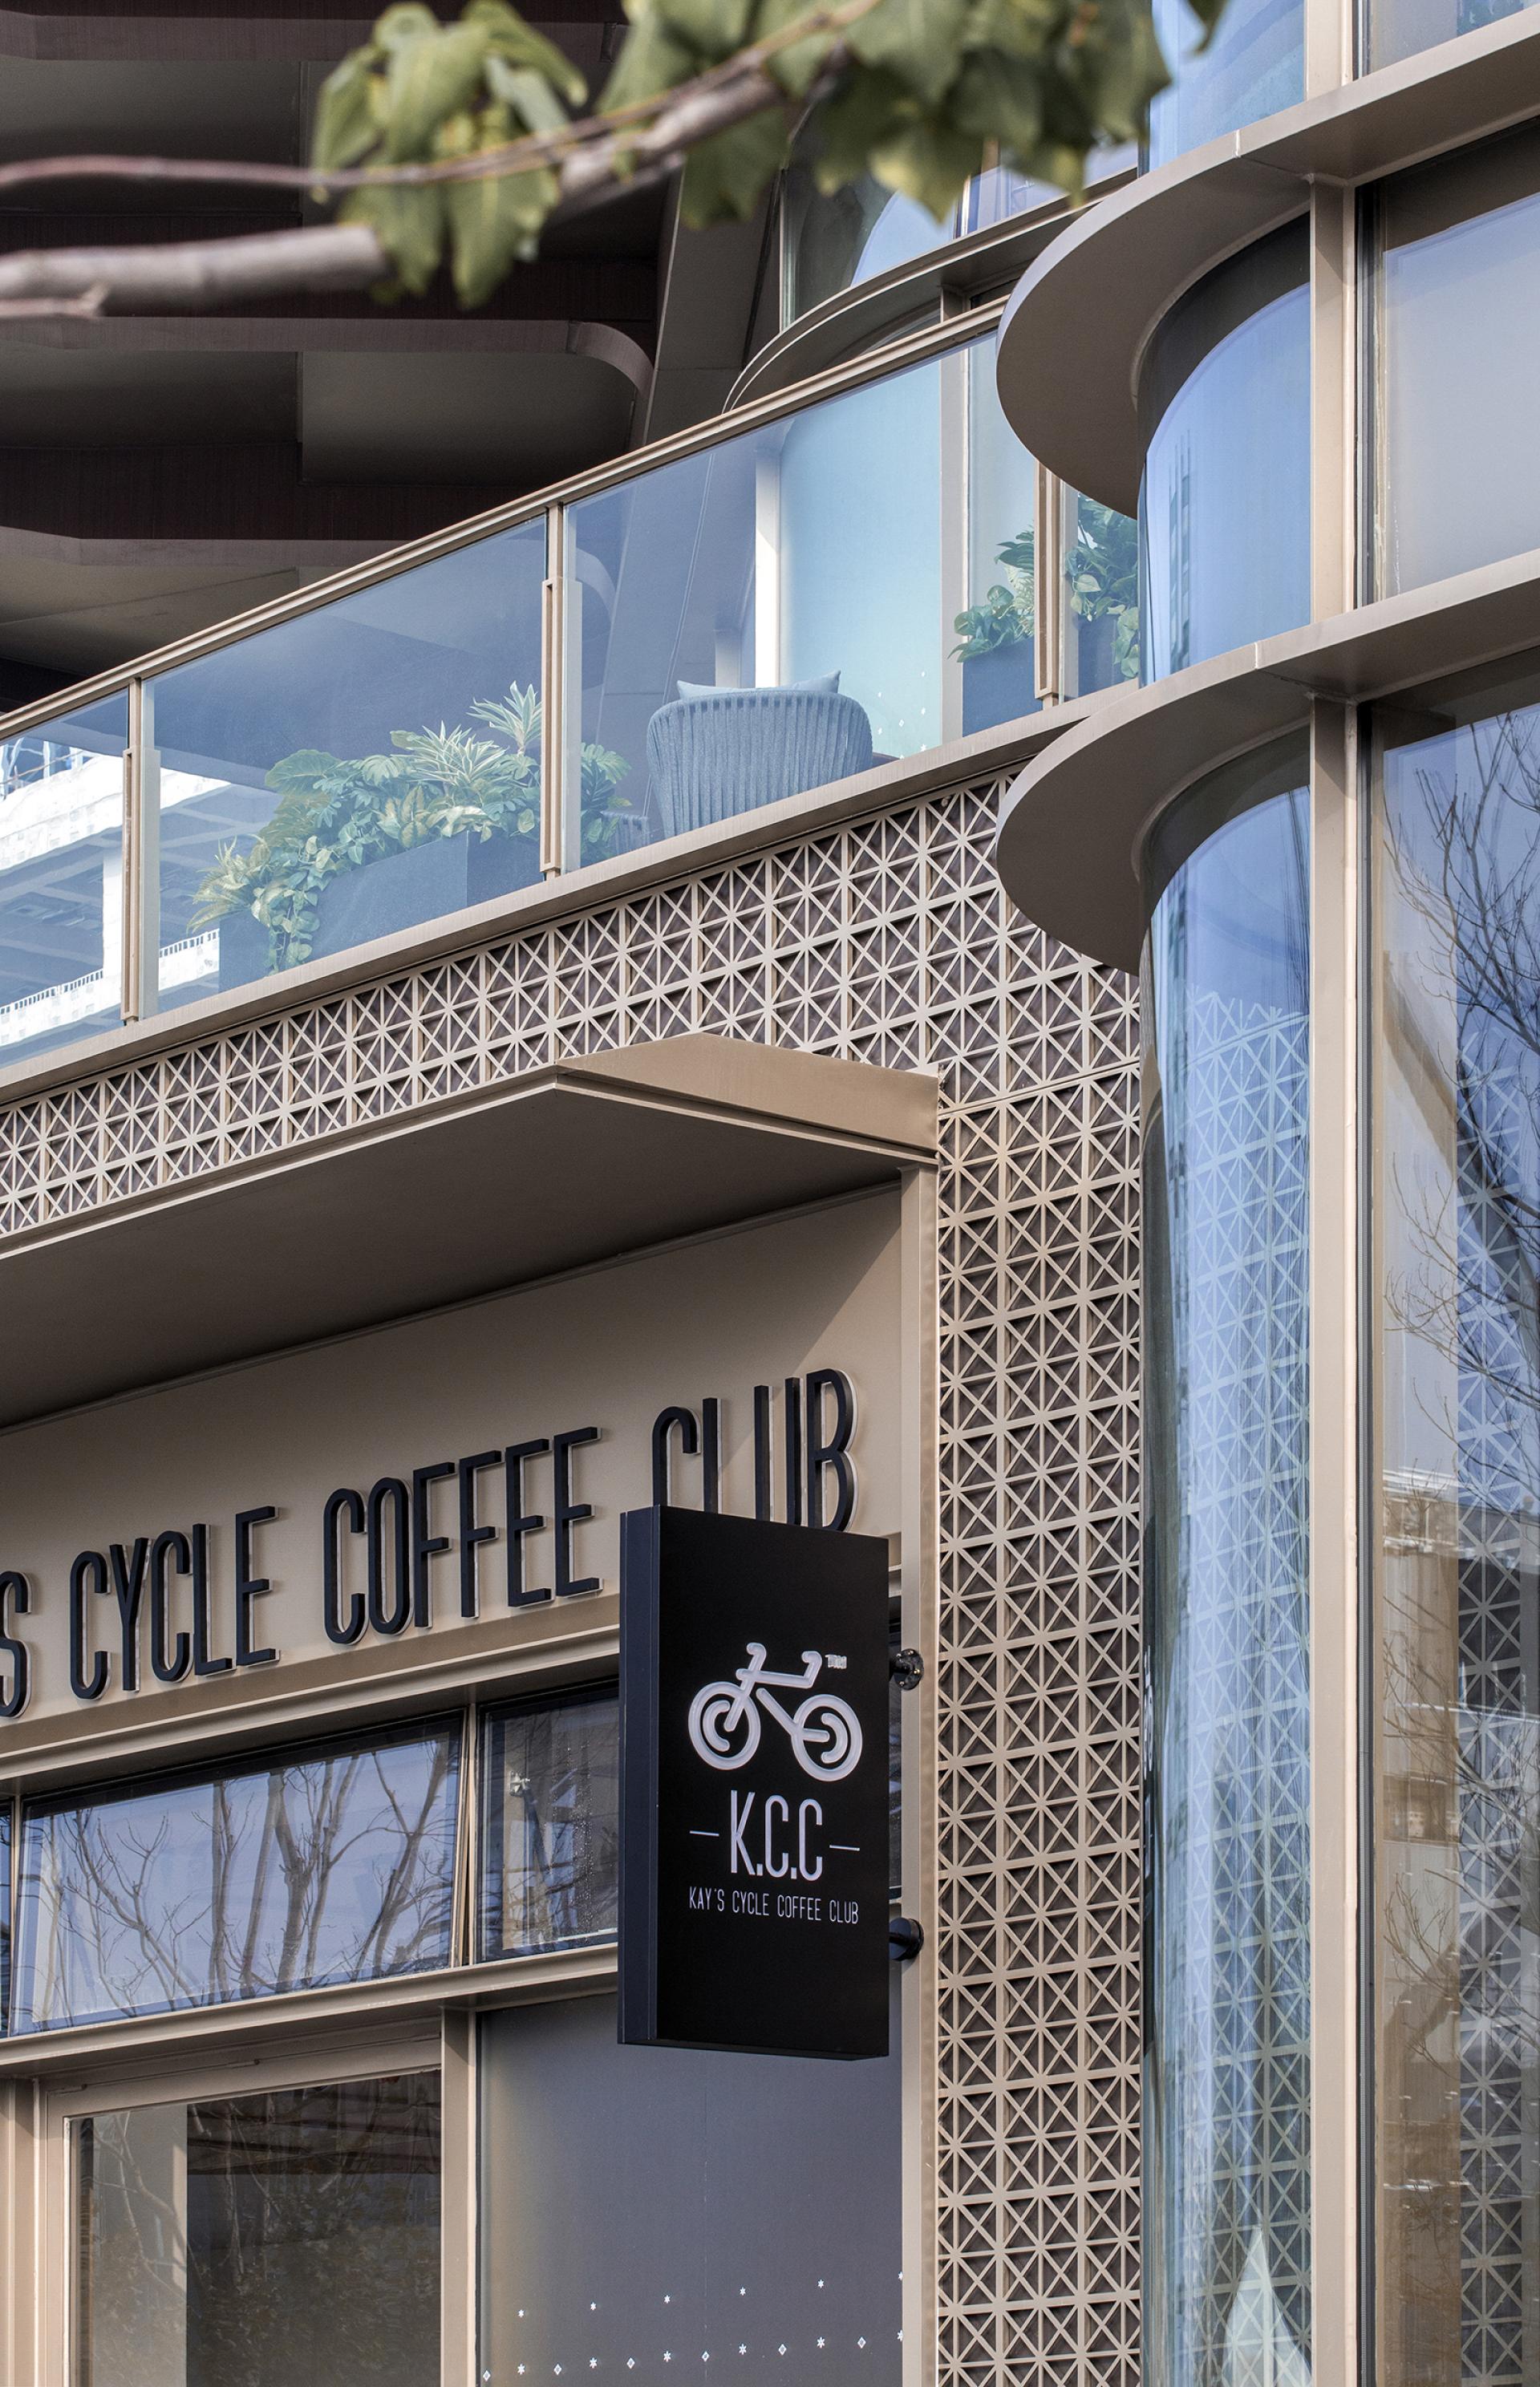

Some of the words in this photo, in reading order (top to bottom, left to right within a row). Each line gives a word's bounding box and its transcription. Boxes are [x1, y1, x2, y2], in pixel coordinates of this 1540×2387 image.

[70, 1506, 279, 1699] CYCLE
[324, 1426, 602, 1644] COFFEE
[731, 1789, 823, 1882] K.C.C
[689, 1886, 725, 1912] KAY'S
[732, 1890, 770, 1916] CYCLE
[777, 1895, 822, 1921] COFFEE
[829, 1899, 858, 1924] CLUB
